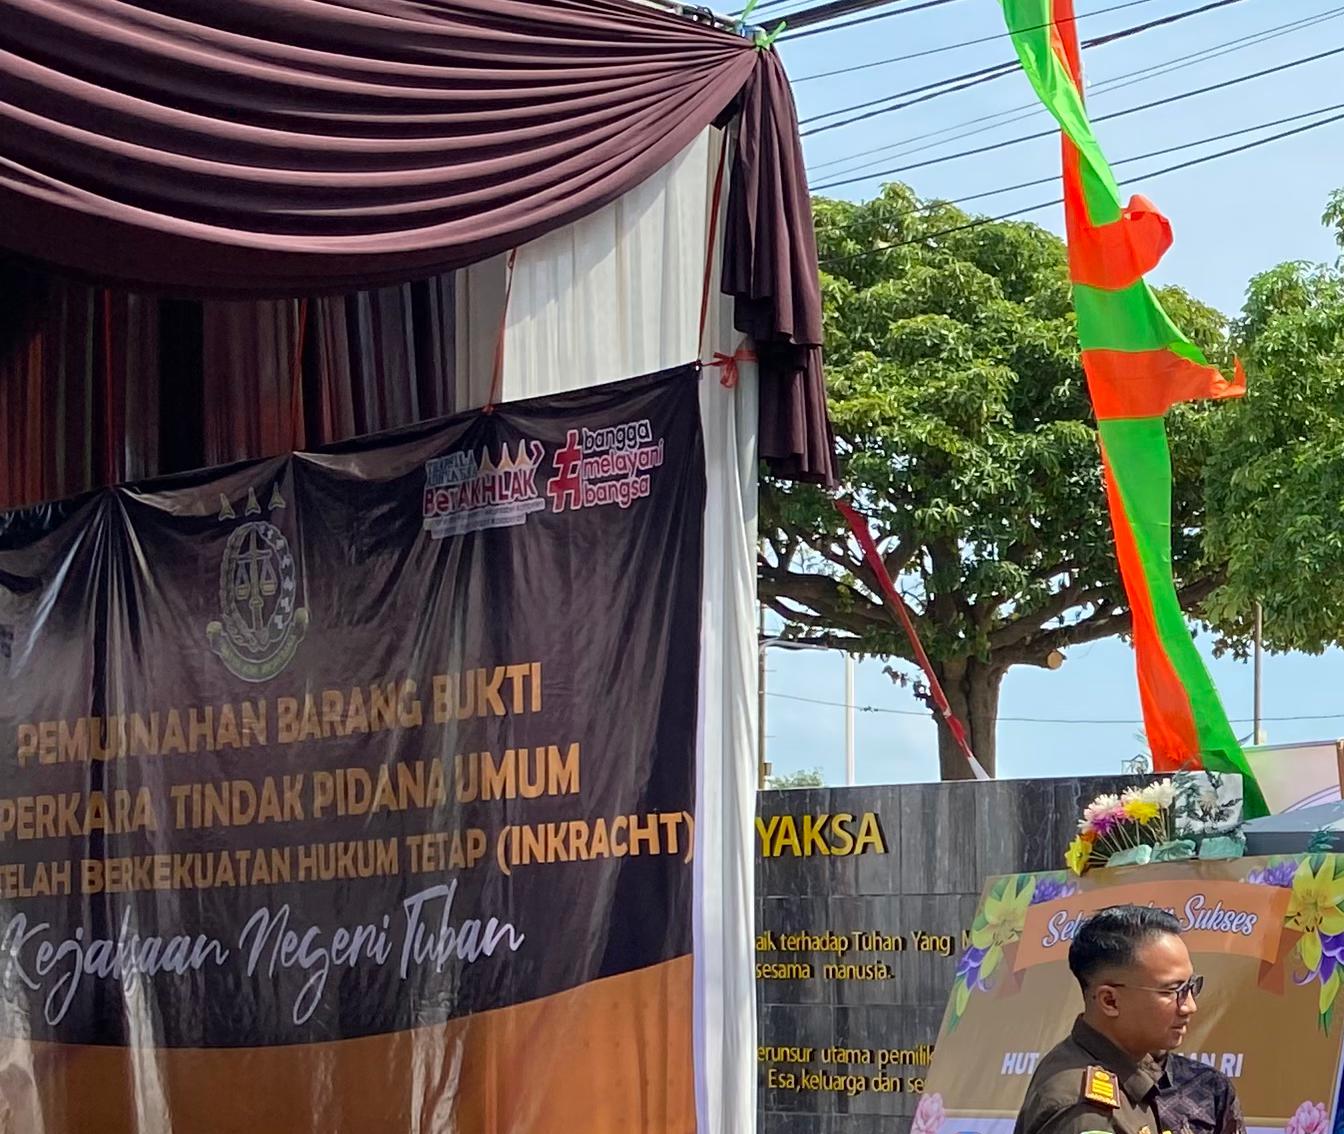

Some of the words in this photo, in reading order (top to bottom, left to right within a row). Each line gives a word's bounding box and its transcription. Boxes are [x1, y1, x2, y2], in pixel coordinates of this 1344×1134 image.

[582, 420, 652, 453] bangga
[582, 438, 664, 480] melayani
[582, 474, 650, 509] bangsa
[17, 700, 267, 769] PEMUNAHAN
[277, 679, 423, 744] BARANG
[432, 661, 542, 725] BUKTI
[0, 786, 158, 841] PERKARA
[171, 774, 305, 829] TINDAK
[313, 758, 446, 818] PIDANA
[455, 742, 580, 804] UMUM
[81, 847, 291, 895] BERKEKUATAN
[298, 837, 398, 881] HUKUM
[406, 828, 487, 874] TETAP
[497, 810, 695, 876] (INKRACHT)
[755, 811, 886, 858] YAKSA
[1180, 893, 1258, 937] Sukses
[239, 903, 391, 1025] Negeri
[402, 878, 525, 980] Tuban
[780, 930, 849, 957] terhadap
[852, 931, 903, 952] Tuhan
[911, 931, 951, 957] Yang
[755, 963, 812, 980] sesama
[821, 1046, 871, 1065] utama
[1220, 1052, 1245, 1078] RI
[872, 1070, 901, 1093] dan
